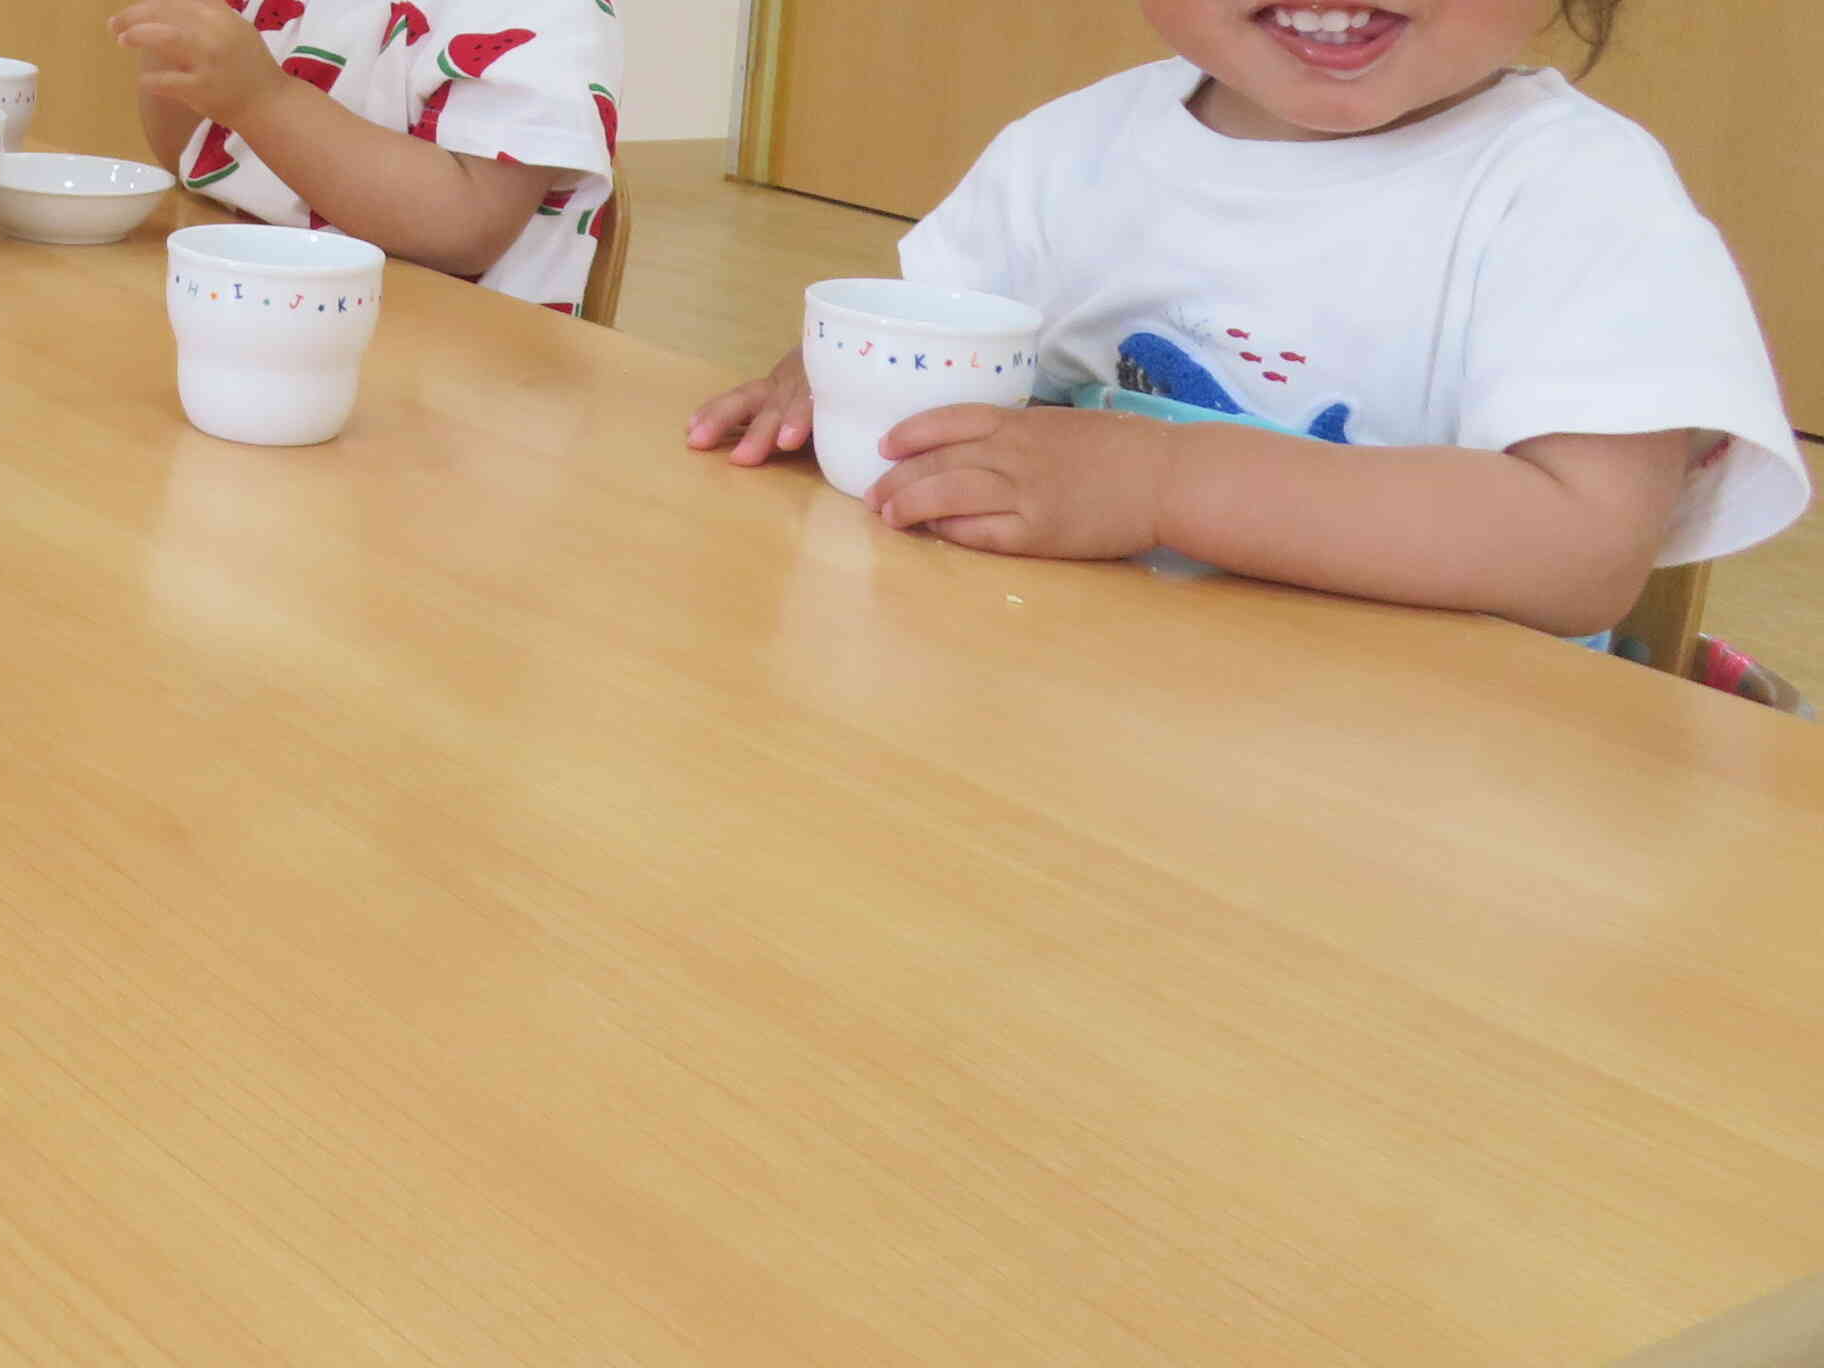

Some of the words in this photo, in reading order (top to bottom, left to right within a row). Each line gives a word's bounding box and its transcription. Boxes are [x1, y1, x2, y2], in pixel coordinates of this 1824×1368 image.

[233, 283, 243, 299] I
[289, 294, 304, 309] J
[337, 297, 347, 313] K
[859, 341, 874, 357] J
[915, 354, 927, 370] K
[971, 352, 984, 369] L
